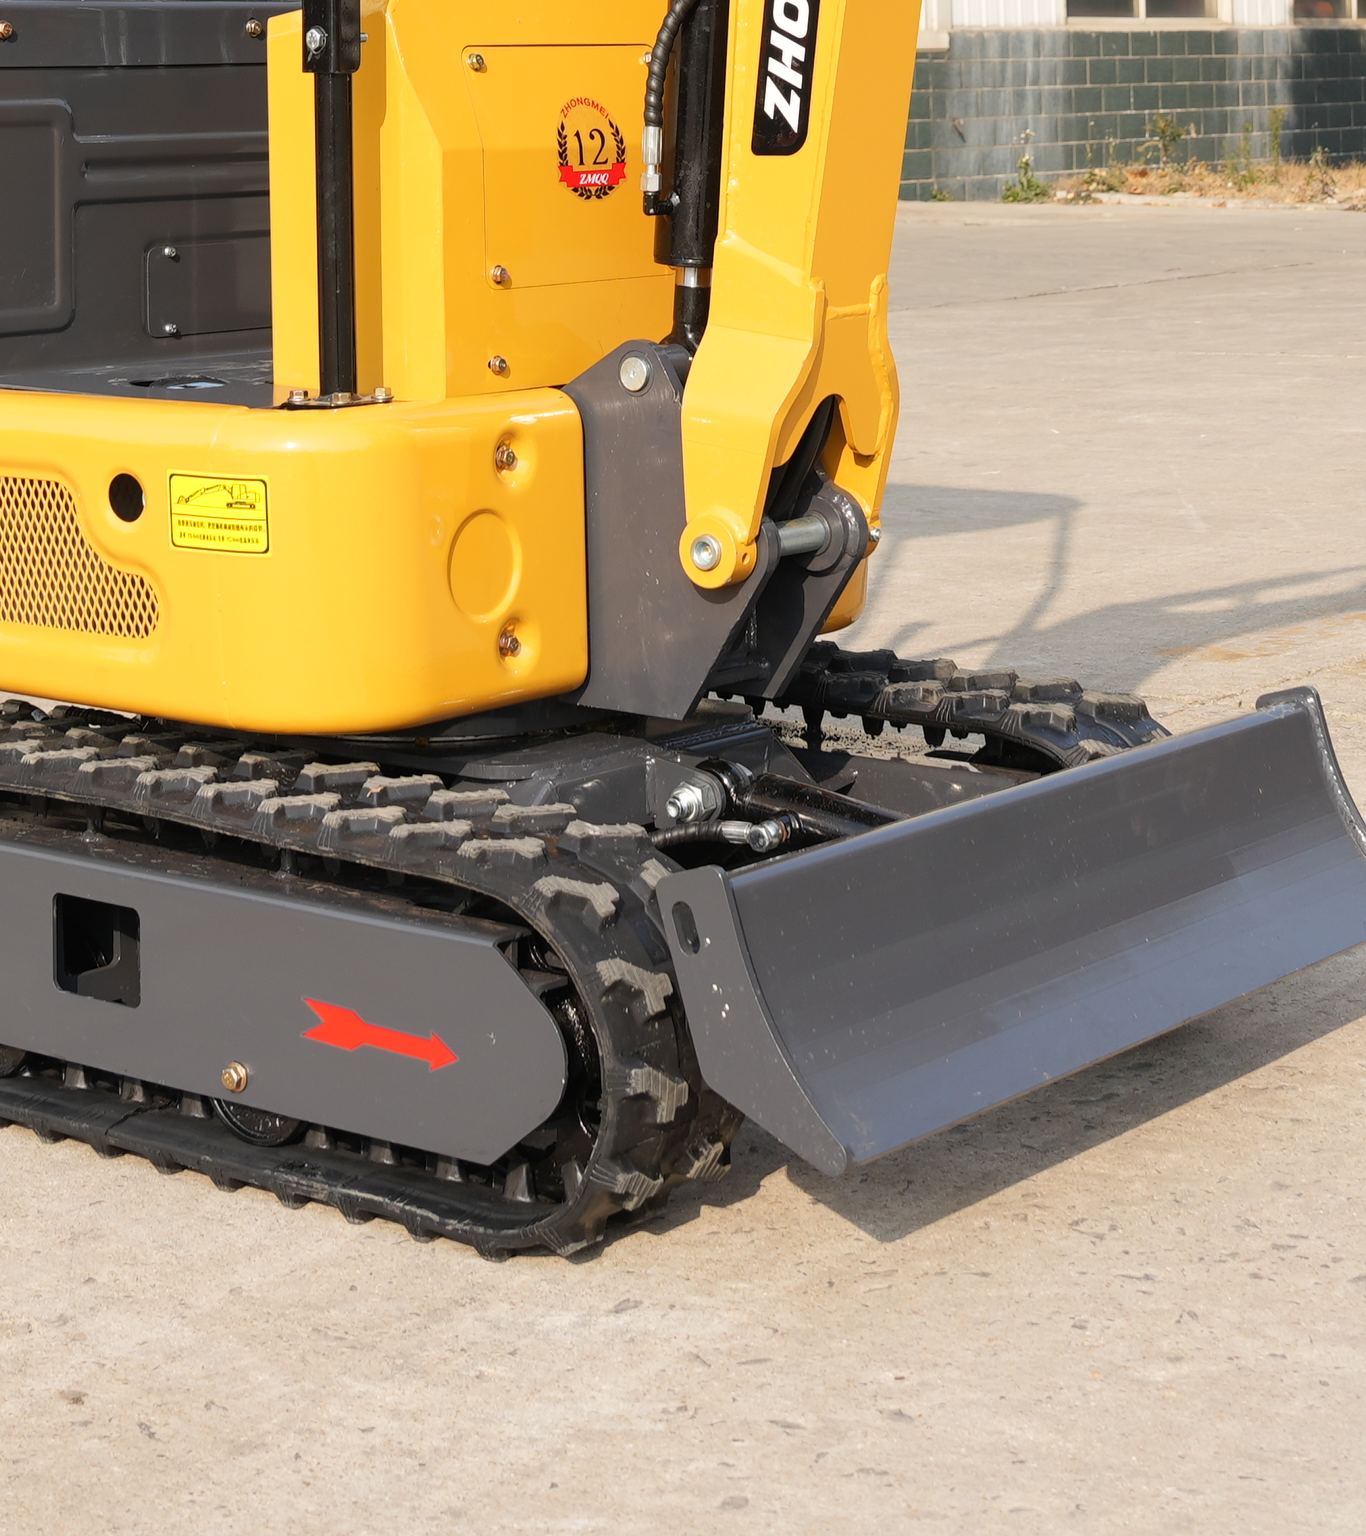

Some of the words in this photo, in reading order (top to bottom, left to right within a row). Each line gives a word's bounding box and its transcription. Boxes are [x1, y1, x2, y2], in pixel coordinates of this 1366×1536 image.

[560, 97, 610, 119] ZHONGMEI
[574, 128, 609, 166] 12
[579, 172, 610, 185] ZMQQ
